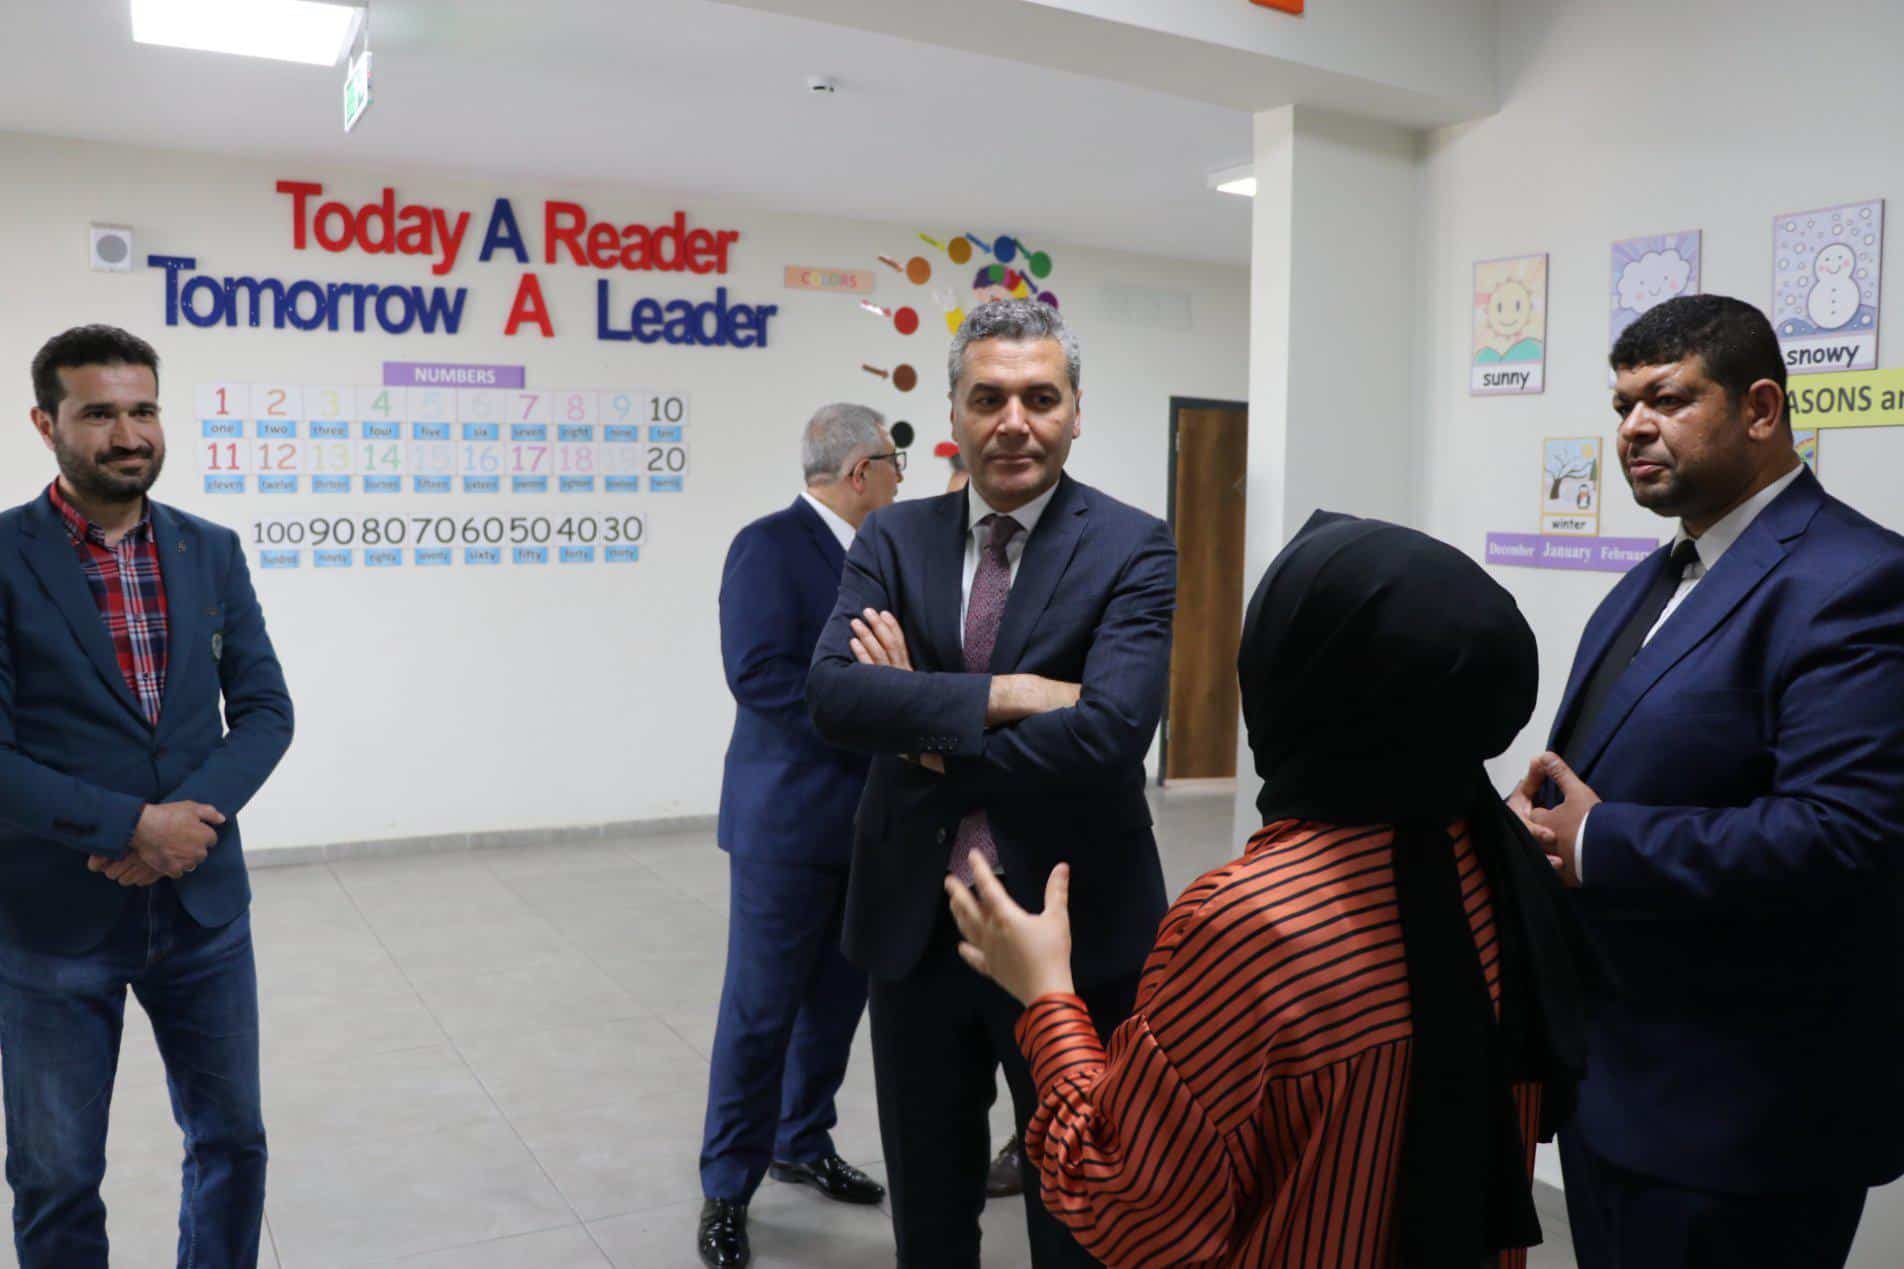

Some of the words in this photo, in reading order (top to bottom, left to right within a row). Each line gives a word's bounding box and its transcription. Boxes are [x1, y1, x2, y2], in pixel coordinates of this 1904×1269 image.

[276, 180, 471, 276] Today
[479, 198, 529, 264] A
[544, 200, 739, 275] Reader
[147, 254, 467, 335] Tomorrow
[504, 273, 555, 338] A
[597, 278, 778, 348] Leader
[1786, 345, 1860, 368] snowy
[414, 367, 496, 384] NUMBERS
[1483, 370, 1530, 390] sunny
[215, 387, 229, 415] 1
[266, 388, 286, 416] 2
[320, 390, 340, 417] 3
[371, 390, 392, 417] 4
[519, 394, 540, 421] 7
[567, 394, 585, 421] 8
[612, 395, 631, 421] 9
[650, 397, 684, 422] 10
[210, 425, 234, 434] one
[264, 424, 288, 434] two
[313, 424, 345, 436] three
[207, 442, 240, 470] 11
[259, 443, 297, 470] 12
[313, 444, 350, 471] 13
[364, 444, 401, 471] 14
[463, 445, 500, 472] 16
[511, 446, 547, 472] 17
[560, 447, 593, 473] 18
[647, 447, 685, 472] 20
[254, 521, 304, 544] 100
[309, 517, 355, 545] 90
[362, 517, 405, 544] 80
[412, 516, 455, 544] 70
[461, 516, 504, 544] 60
[510, 516, 551, 543] 50
[557, 516, 598, 542] 40
[603, 516, 642, 542] 30
[1551, 519, 1587, 530] winter
[1489, 542, 1535, 558] December
[1543, 541, 1592, 563] January
